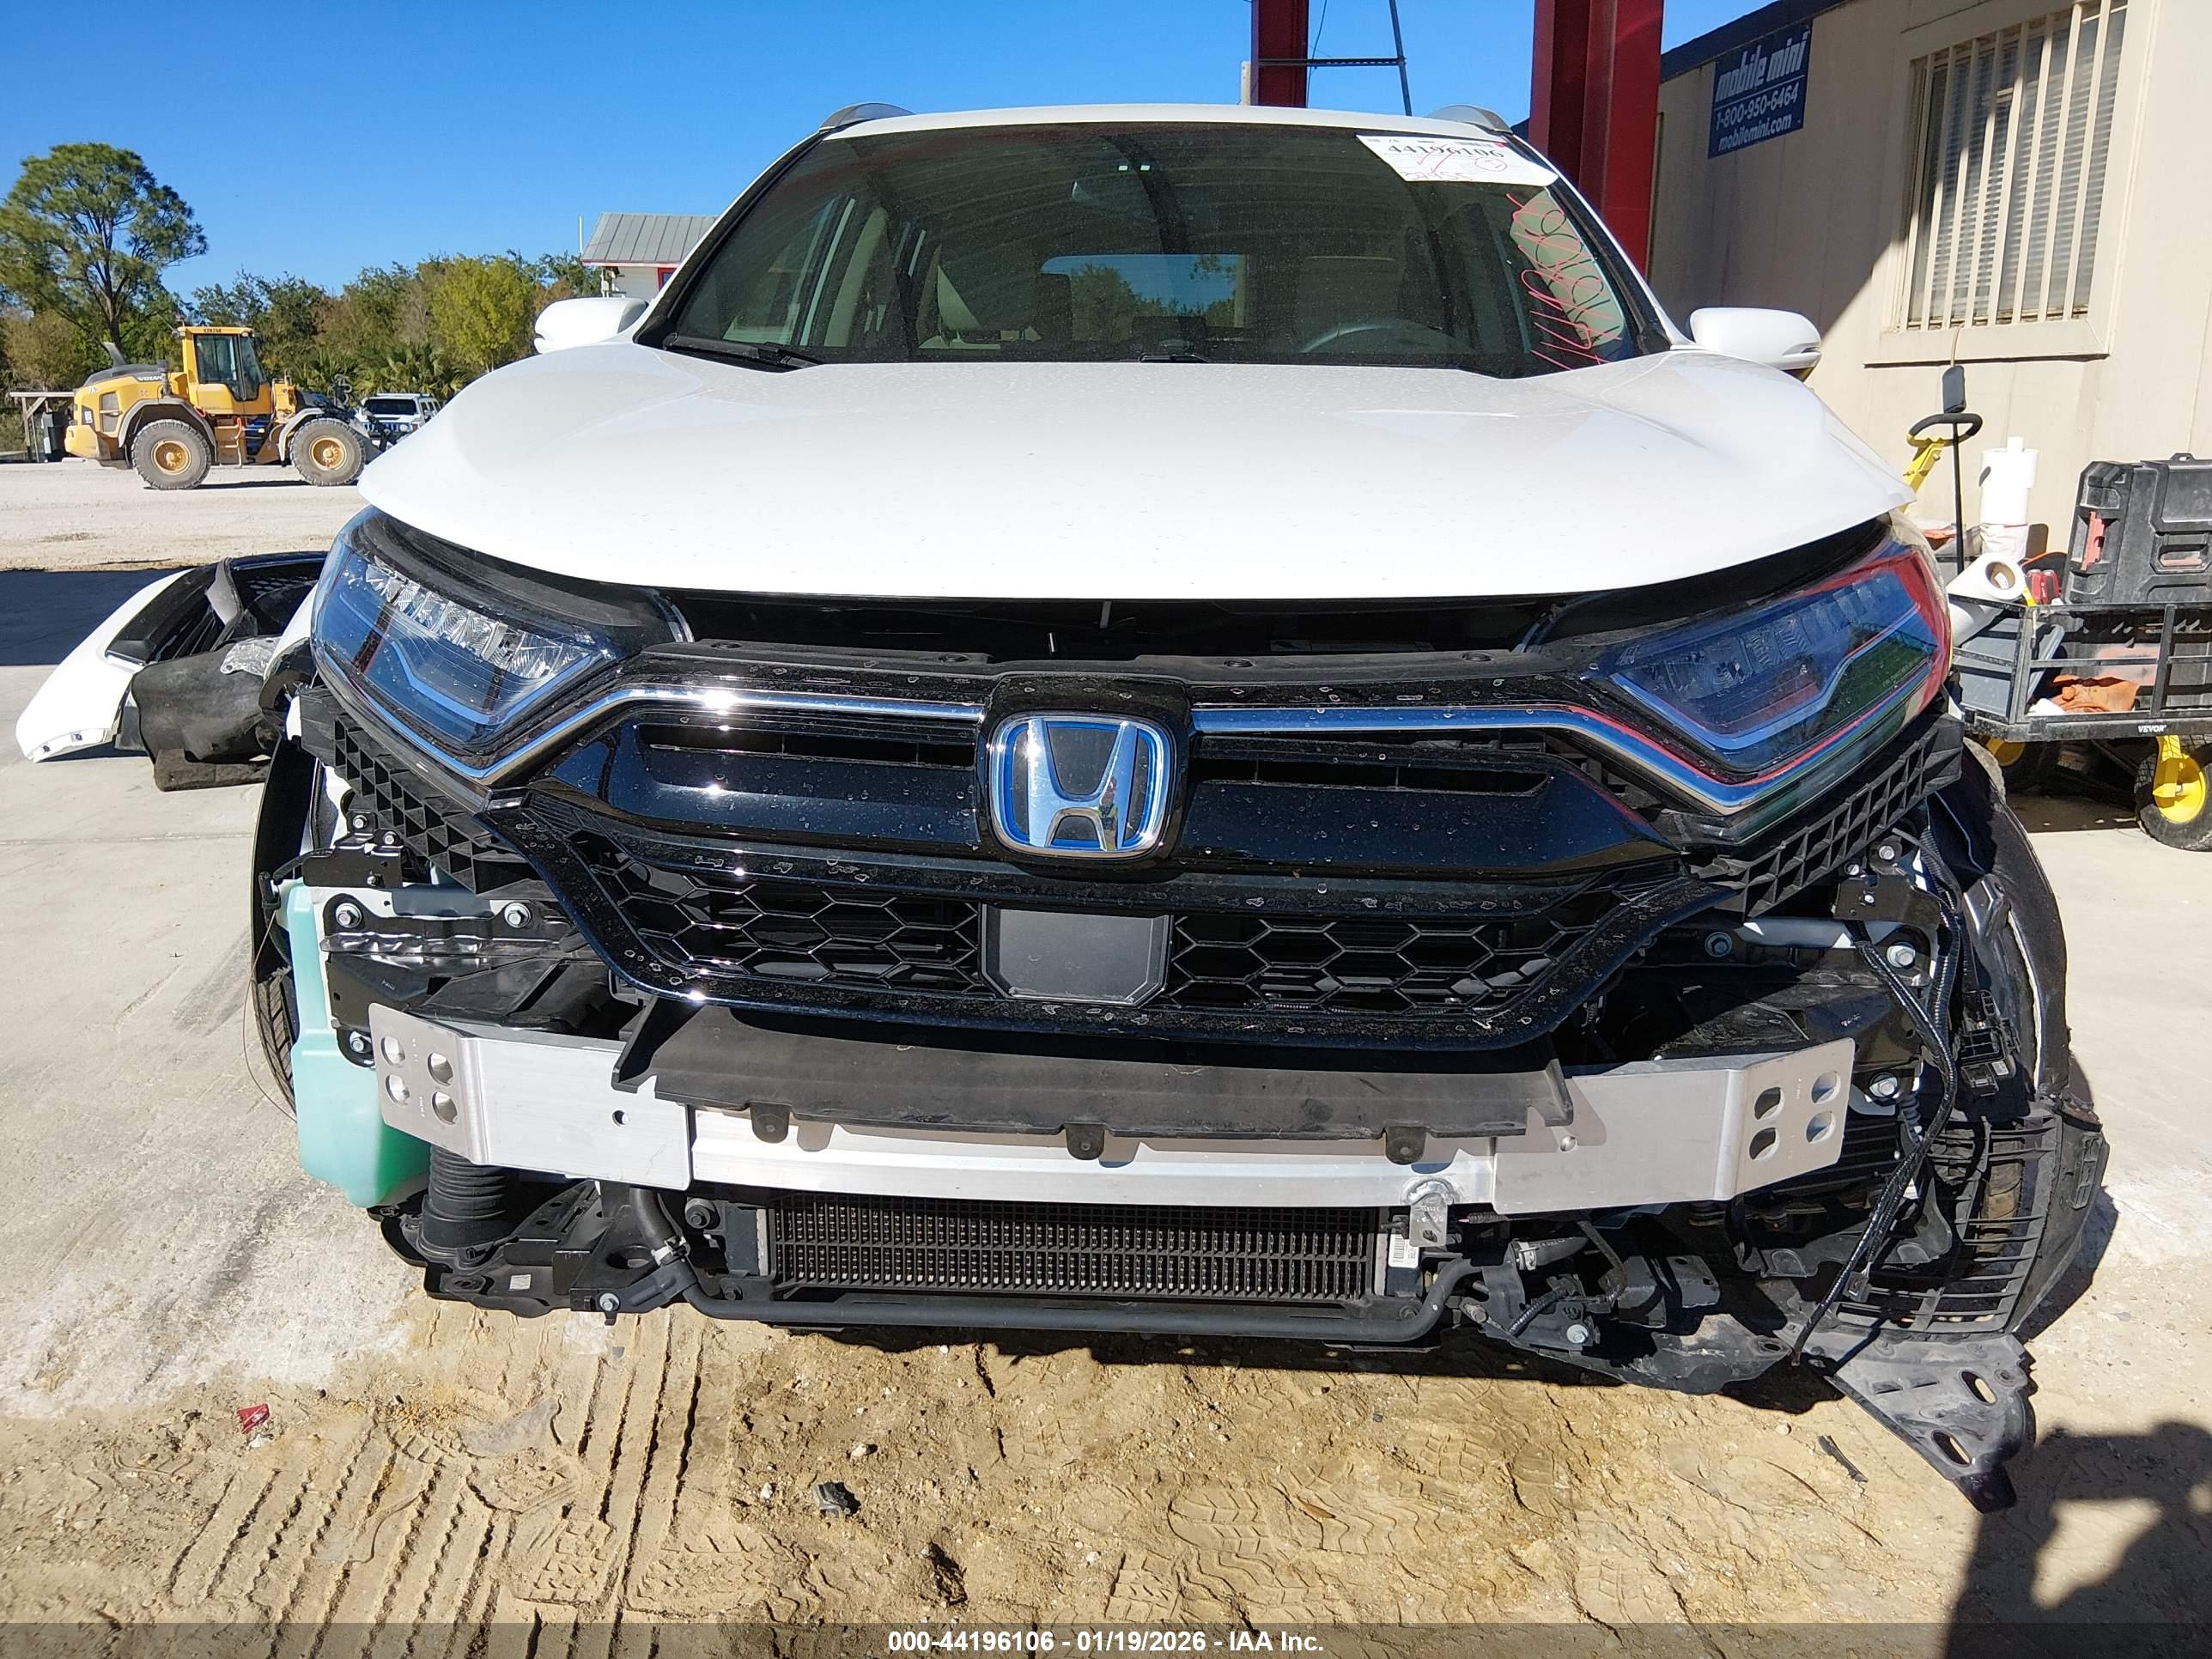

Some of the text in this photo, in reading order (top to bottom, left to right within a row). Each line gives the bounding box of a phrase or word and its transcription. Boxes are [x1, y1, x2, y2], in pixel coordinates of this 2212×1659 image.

[1716, 30, 1810, 103] mobile mini
[1717, 82, 1800, 131] 1-800-950-6464
[1388, 144, 1505, 158] 44196106
[1718, 113, 1792, 151] mobilemini.com
